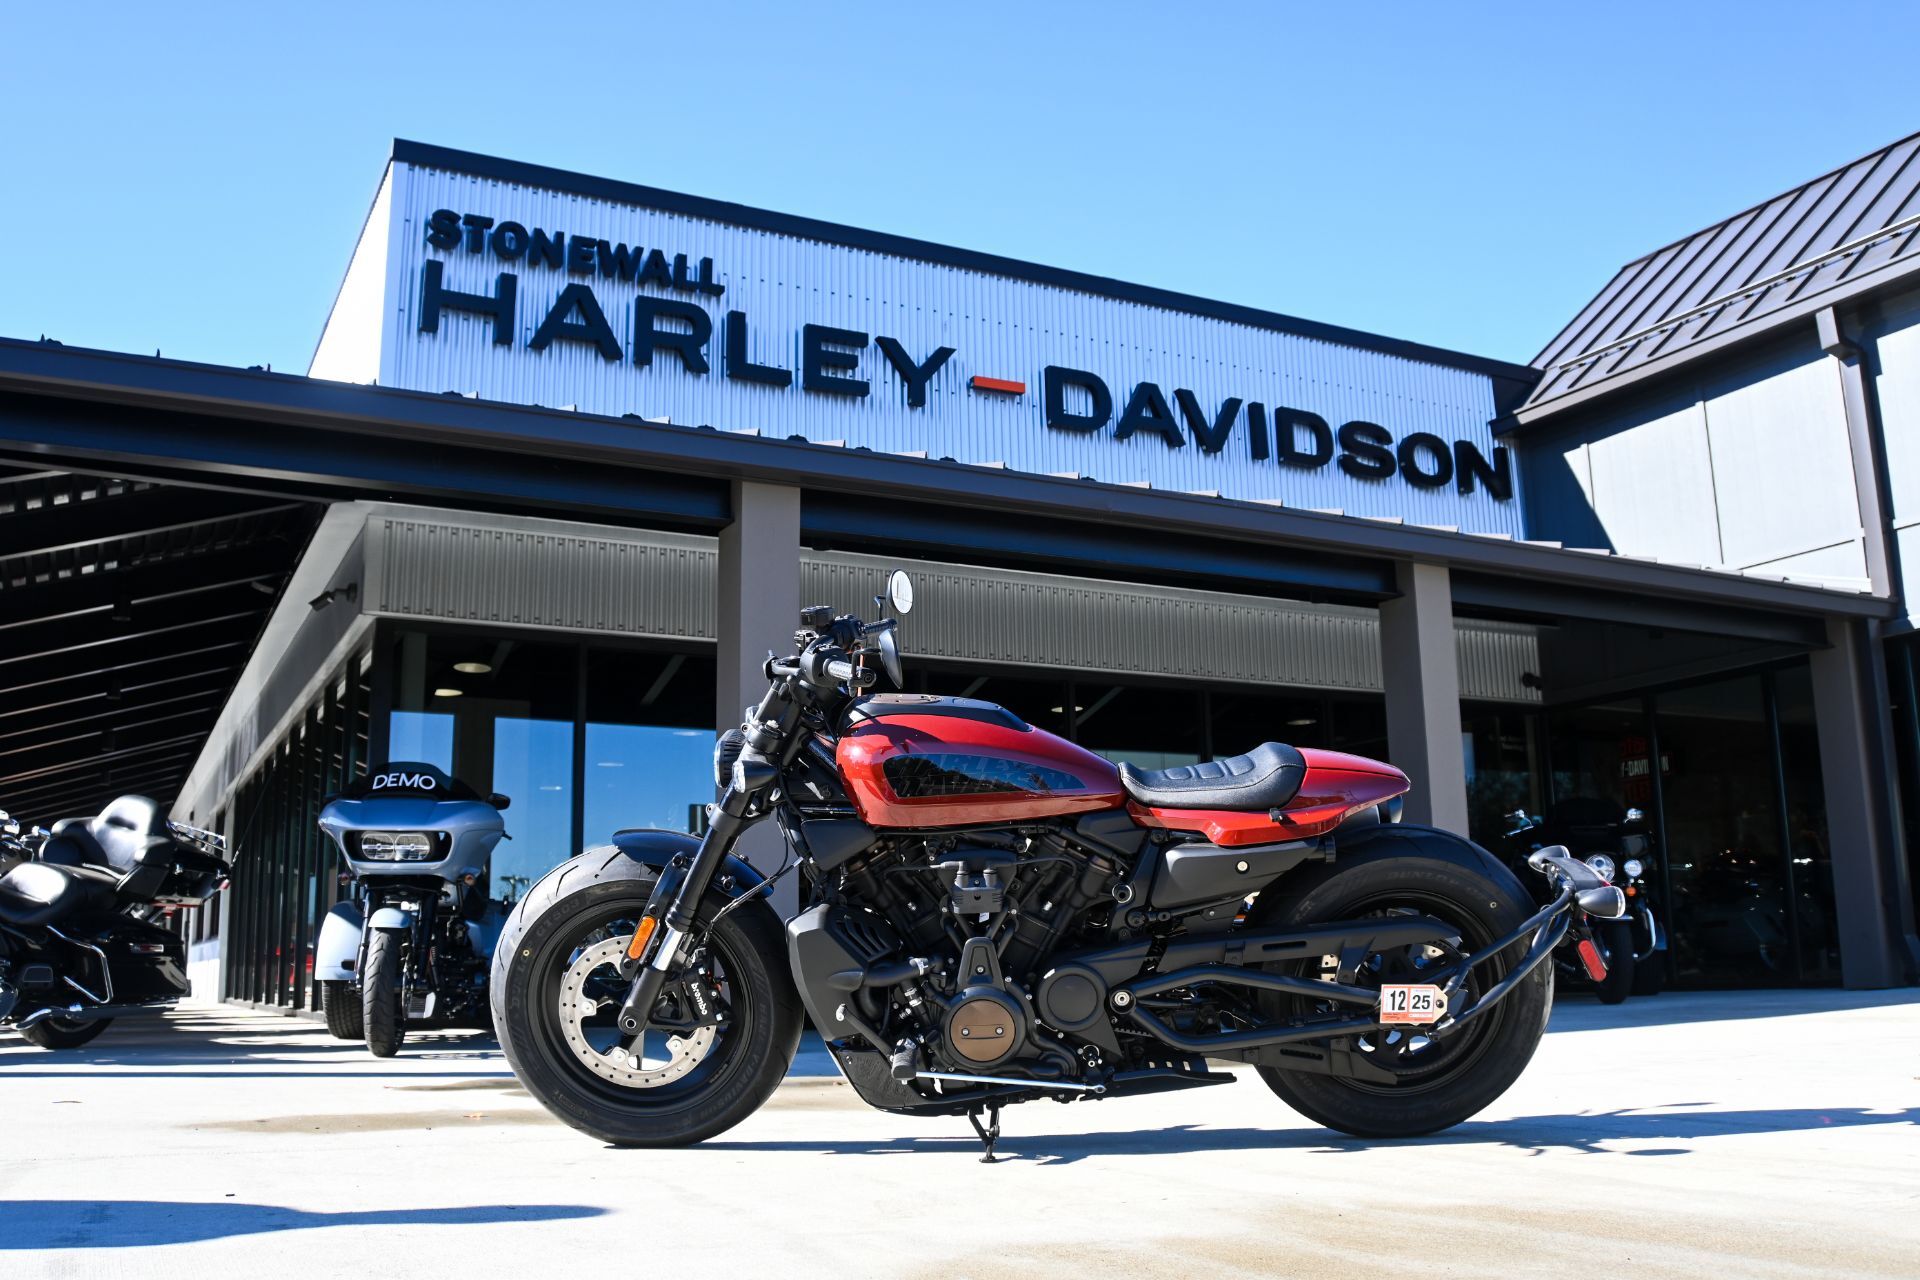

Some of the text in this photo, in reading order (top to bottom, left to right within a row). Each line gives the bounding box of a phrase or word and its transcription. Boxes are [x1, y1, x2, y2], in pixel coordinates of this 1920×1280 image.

[427, 208, 725, 296] STONEWALL
[372, 772, 437, 790] DEMO
[690, 981, 708, 1016] brembo
[1390, 989, 1431, 1011] 12 25
